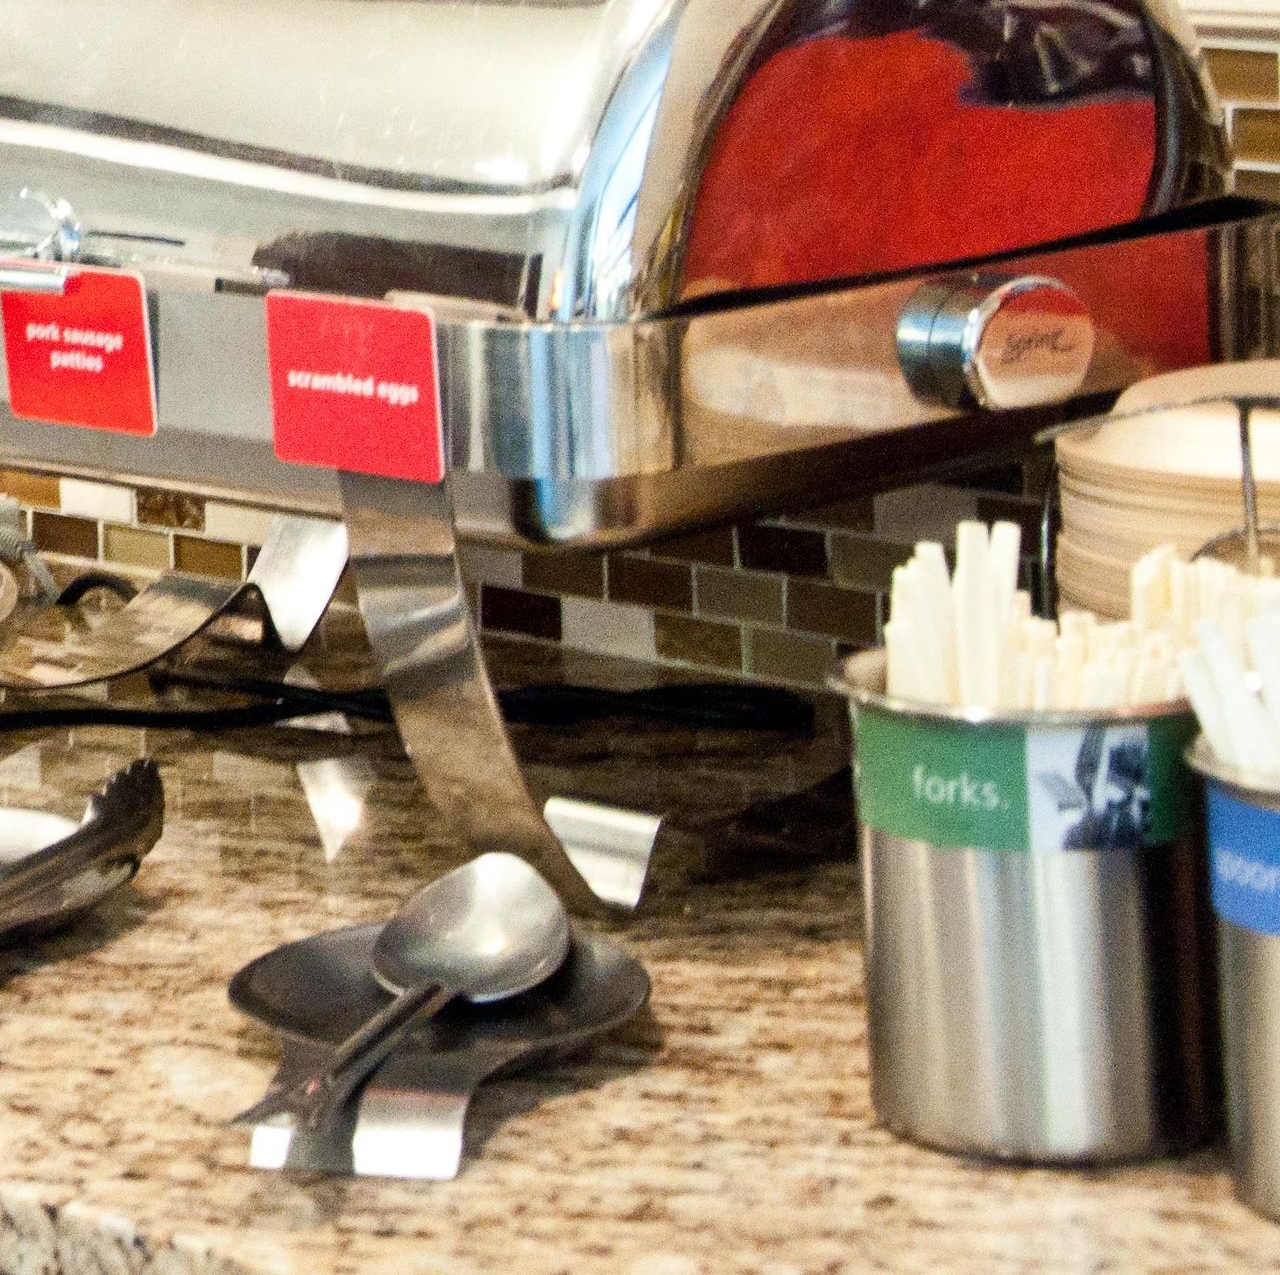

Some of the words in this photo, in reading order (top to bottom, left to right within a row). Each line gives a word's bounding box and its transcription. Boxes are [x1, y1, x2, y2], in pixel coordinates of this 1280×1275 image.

[26, 321, 60, 342] pork
[63, 327, 125, 353] sausage
[49, 350, 104, 374] patties
[287, 369, 375, 397] scrambled
[376, 380, 420, 406] eggs
